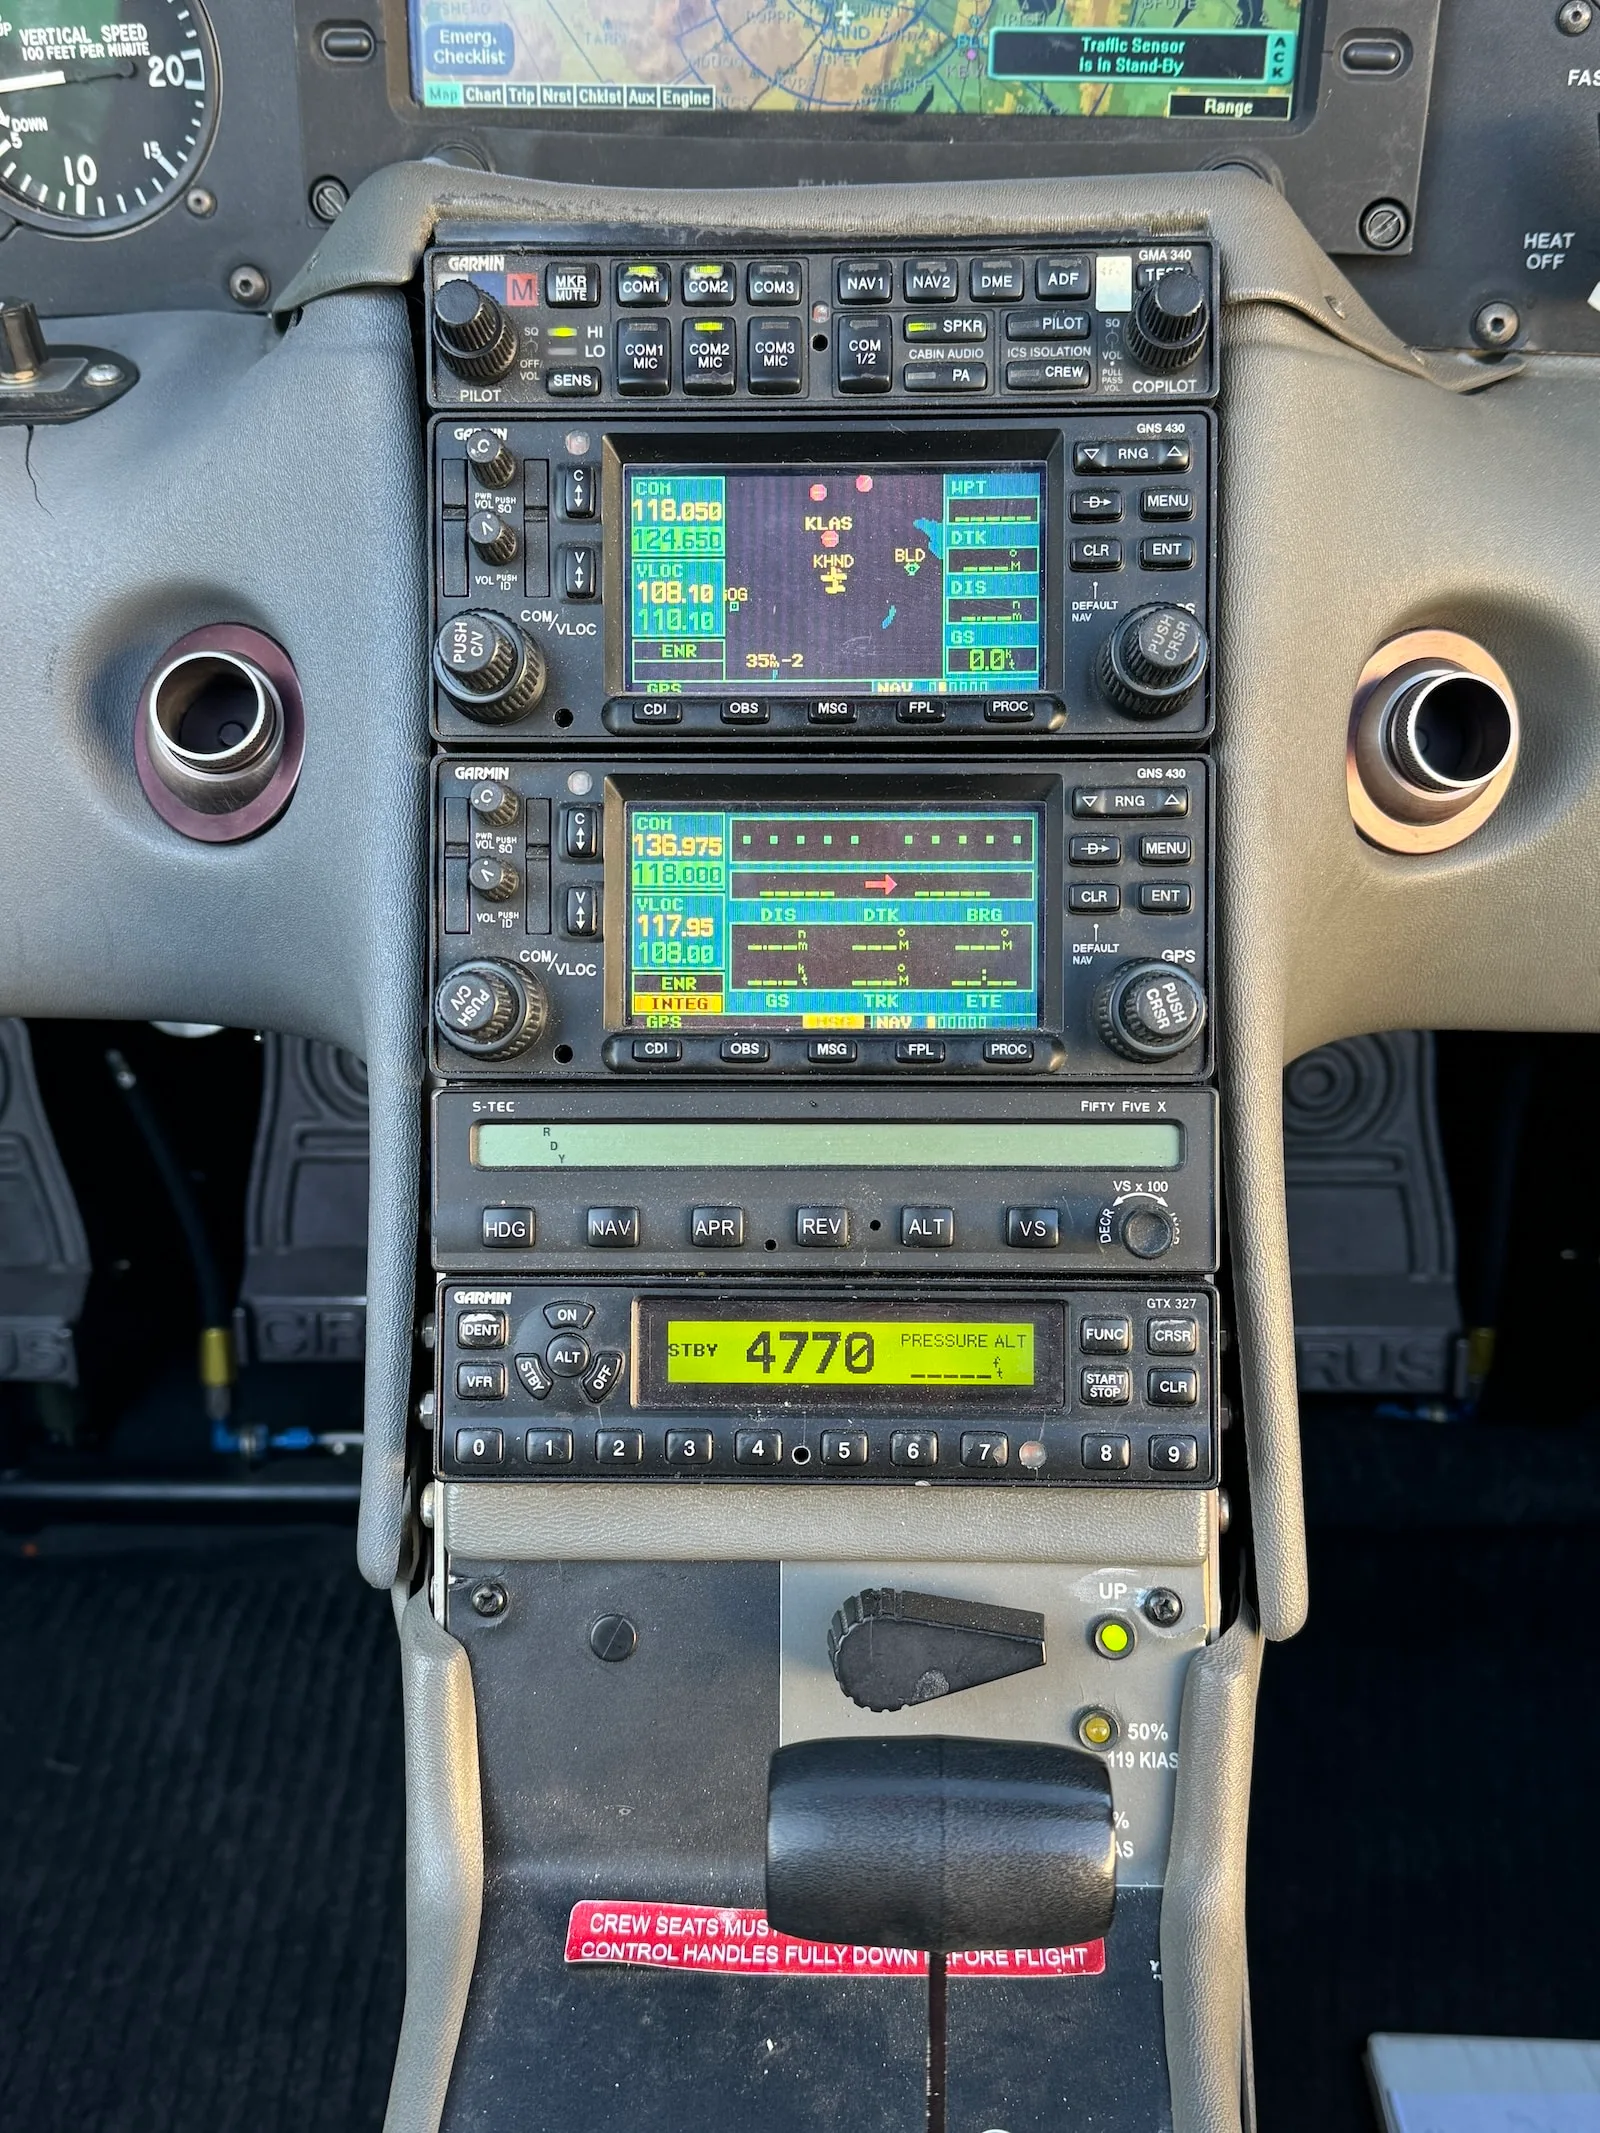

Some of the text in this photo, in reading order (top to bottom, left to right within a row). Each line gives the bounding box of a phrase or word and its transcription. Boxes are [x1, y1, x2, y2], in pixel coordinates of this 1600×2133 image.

[19, 23, 148, 46] VERTICAL SPEED
[440, 29, 497, 46] Emerg.
[22, 41, 150, 61] 100 FEET PER MINUTE
[1082, 37, 1186, 54] Traffic Sensor
[433, 50, 507, 65] Checklist
[148, 55, 184, 88] 20
[1115, 57, 1184, 77] Stand-By
[429, 87, 459, 104] Map
[466, 87, 500, 102] Chart
[509, 87, 535, 105] Trip
[543, 88, 572, 103] Nrst
[579, 88, 622, 104] Chklst
[629, 89, 656, 104] Aux
[663, 91, 710, 108] Engine
[1205, 98, 1253, 116] Range
[11, 117, 48, 132] DOWN
[143, 141, 162, 160] 15
[64, 154, 97, 187] 10
[1524, 232, 1575, 249] HEAT
[1139, 250, 1192, 261] GMA 340
[1526, 253, 1565, 270] OFF
[448, 256, 505, 272] GARMIN
[555, 275, 587, 288] MKR
[847, 277, 885, 290] NAV1
[912, 276, 951, 290] NAV2
[981, 275, 1013, 289] DME
[1048, 272, 1079, 286] ADF
[623, 281, 660, 294] COM1
[688, 281, 729, 294] COM2
[754, 281, 795, 294] COM3
[555, 289, 587, 301] MUTE
[943, 319, 983, 333] SPKR
[1042, 317, 1084, 331] PILOT
[625, 344, 664, 356] COM1
[689, 344, 730, 356] COM2
[848, 340, 881, 352] COM
[1007, 345, 1091, 358] ICS ISOLATION
[855, 352, 877, 366] 1/2
[908, 348, 984, 361] CABIN AUDIO
[1102, 351, 1123, 360] VOL
[633, 357, 658, 370] MIC
[698, 356, 723, 369] MIC
[952, 369, 970, 382] PA
[1045, 366, 1084, 379] CREW
[1102, 368, 1123, 376] PULL
[553, 374, 592, 387] SENS
[1101, 376, 1123, 384] PASS
[1132, 379, 1198, 394] COPILOT
[460, 389, 502, 403] PILOT
[1136, 423, 1186, 434] GNS 430
[1118, 448, 1149, 460] RNG
[636, 481, 672, 496] COM
[951, 480, 987, 495] WPT
[474, 500, 495, 509] VOL
[495, 497, 517, 505] PUSH
[1147, 495, 1189, 507] MENU
[632, 498, 723, 522] 118.050
[804, 516, 853, 531] KLAS
[633, 528, 722, 550] 124.650
[951, 530, 987, 545] DTK
[894, 548, 926, 563] BLD
[1083, 544, 1110, 557] CLR
[1152, 543, 1182, 556] ENT
[813, 554, 855, 569] KHND
[636, 563, 684, 578] VLOC
[637, 581, 714, 605] 108.10
[951, 580, 987, 595] DIS
[1071, 601, 1119, 611] DEFAULT
[638, 608, 714, 632] 110.10
[1071, 613, 1093, 622] NAV
[951, 630, 975, 645] GS
[1148, 614, 1175, 655] PUSH
[1164, 620, 1191, 661] CRSR
[661, 644, 698, 658] ENR
[643, 703, 667, 716] CDI
[729, 702, 759, 715] OBS
[818, 702, 848, 714] MSG
[908, 701, 935, 713] FPL
[992, 701, 1029, 713] PROC
[454, 766, 510, 781] GARMIN
[1136, 768, 1186, 779] GNS 430
[633, 833, 723, 857] 136.975
[633, 863, 722, 885] 118.000
[966, 908, 1003, 922] BRG
[637, 914, 714, 938] 117.95
[638, 941, 714, 964] 108.00
[1161, 949, 1196, 964] GPS
[652, 997, 709, 1011] INTEG
[864, 993, 899, 1008] TRK
[966, 993, 1003, 1008] ETE
[471, 1101, 515, 1113] S-TEC
[1080, 1100, 1167, 1113] FIFTY FIVE X
[1112, 1180, 1132, 1192] VS
[1147, 1180, 1169, 1193] 100
[485, 1221, 526, 1238] HDG
[592, 1220, 631, 1237] NAV
[694, 1219, 735, 1236] APR
[802, 1219, 842, 1236] REV
[908, 1219, 945, 1236] ALT
[1019, 1220, 1046, 1238] VS
[1098, 1208, 1115, 1244] DECR
[454, 1291, 512, 1305] GARMIN
[1146, 1298, 1197, 1309] GTX 327
[557, 1308, 577, 1321] ON
[463, 1323, 500, 1337] IDENT
[1086, 1328, 1124, 1341] FUNC
[1154, 1330, 1191, 1343] CRSR
[901, 1333, 1028, 1349] PRESSURE ALT
[553, 1351, 581, 1364] ALT
[668, 1330, 875, 1375] STBY 4770
[467, 1375, 493, 1388] VFR
[520, 1360, 545, 1393] STBY
[593, 1365, 613, 1390] OFF
[1086, 1373, 1124, 1385] START
[1089, 1387, 1121, 1399] STOP
[1098, 1582, 1128, 1600] UP
[1127, 1723, 1169, 1742] 50%
[1108, 1751, 1180, 1769] 119 KIAS
[590, 1912, 651, 1934] CREW
[655, 1915, 719, 1936] SEATS
[581, 1941, 679, 1961] CONTROL
[683, 1943, 779, 1964] HANDLES
[785, 1945, 849, 1965] FULLY
[852, 1947, 918, 1965] DOWN
[1015, 1947, 1088, 1966] FLIGHT
